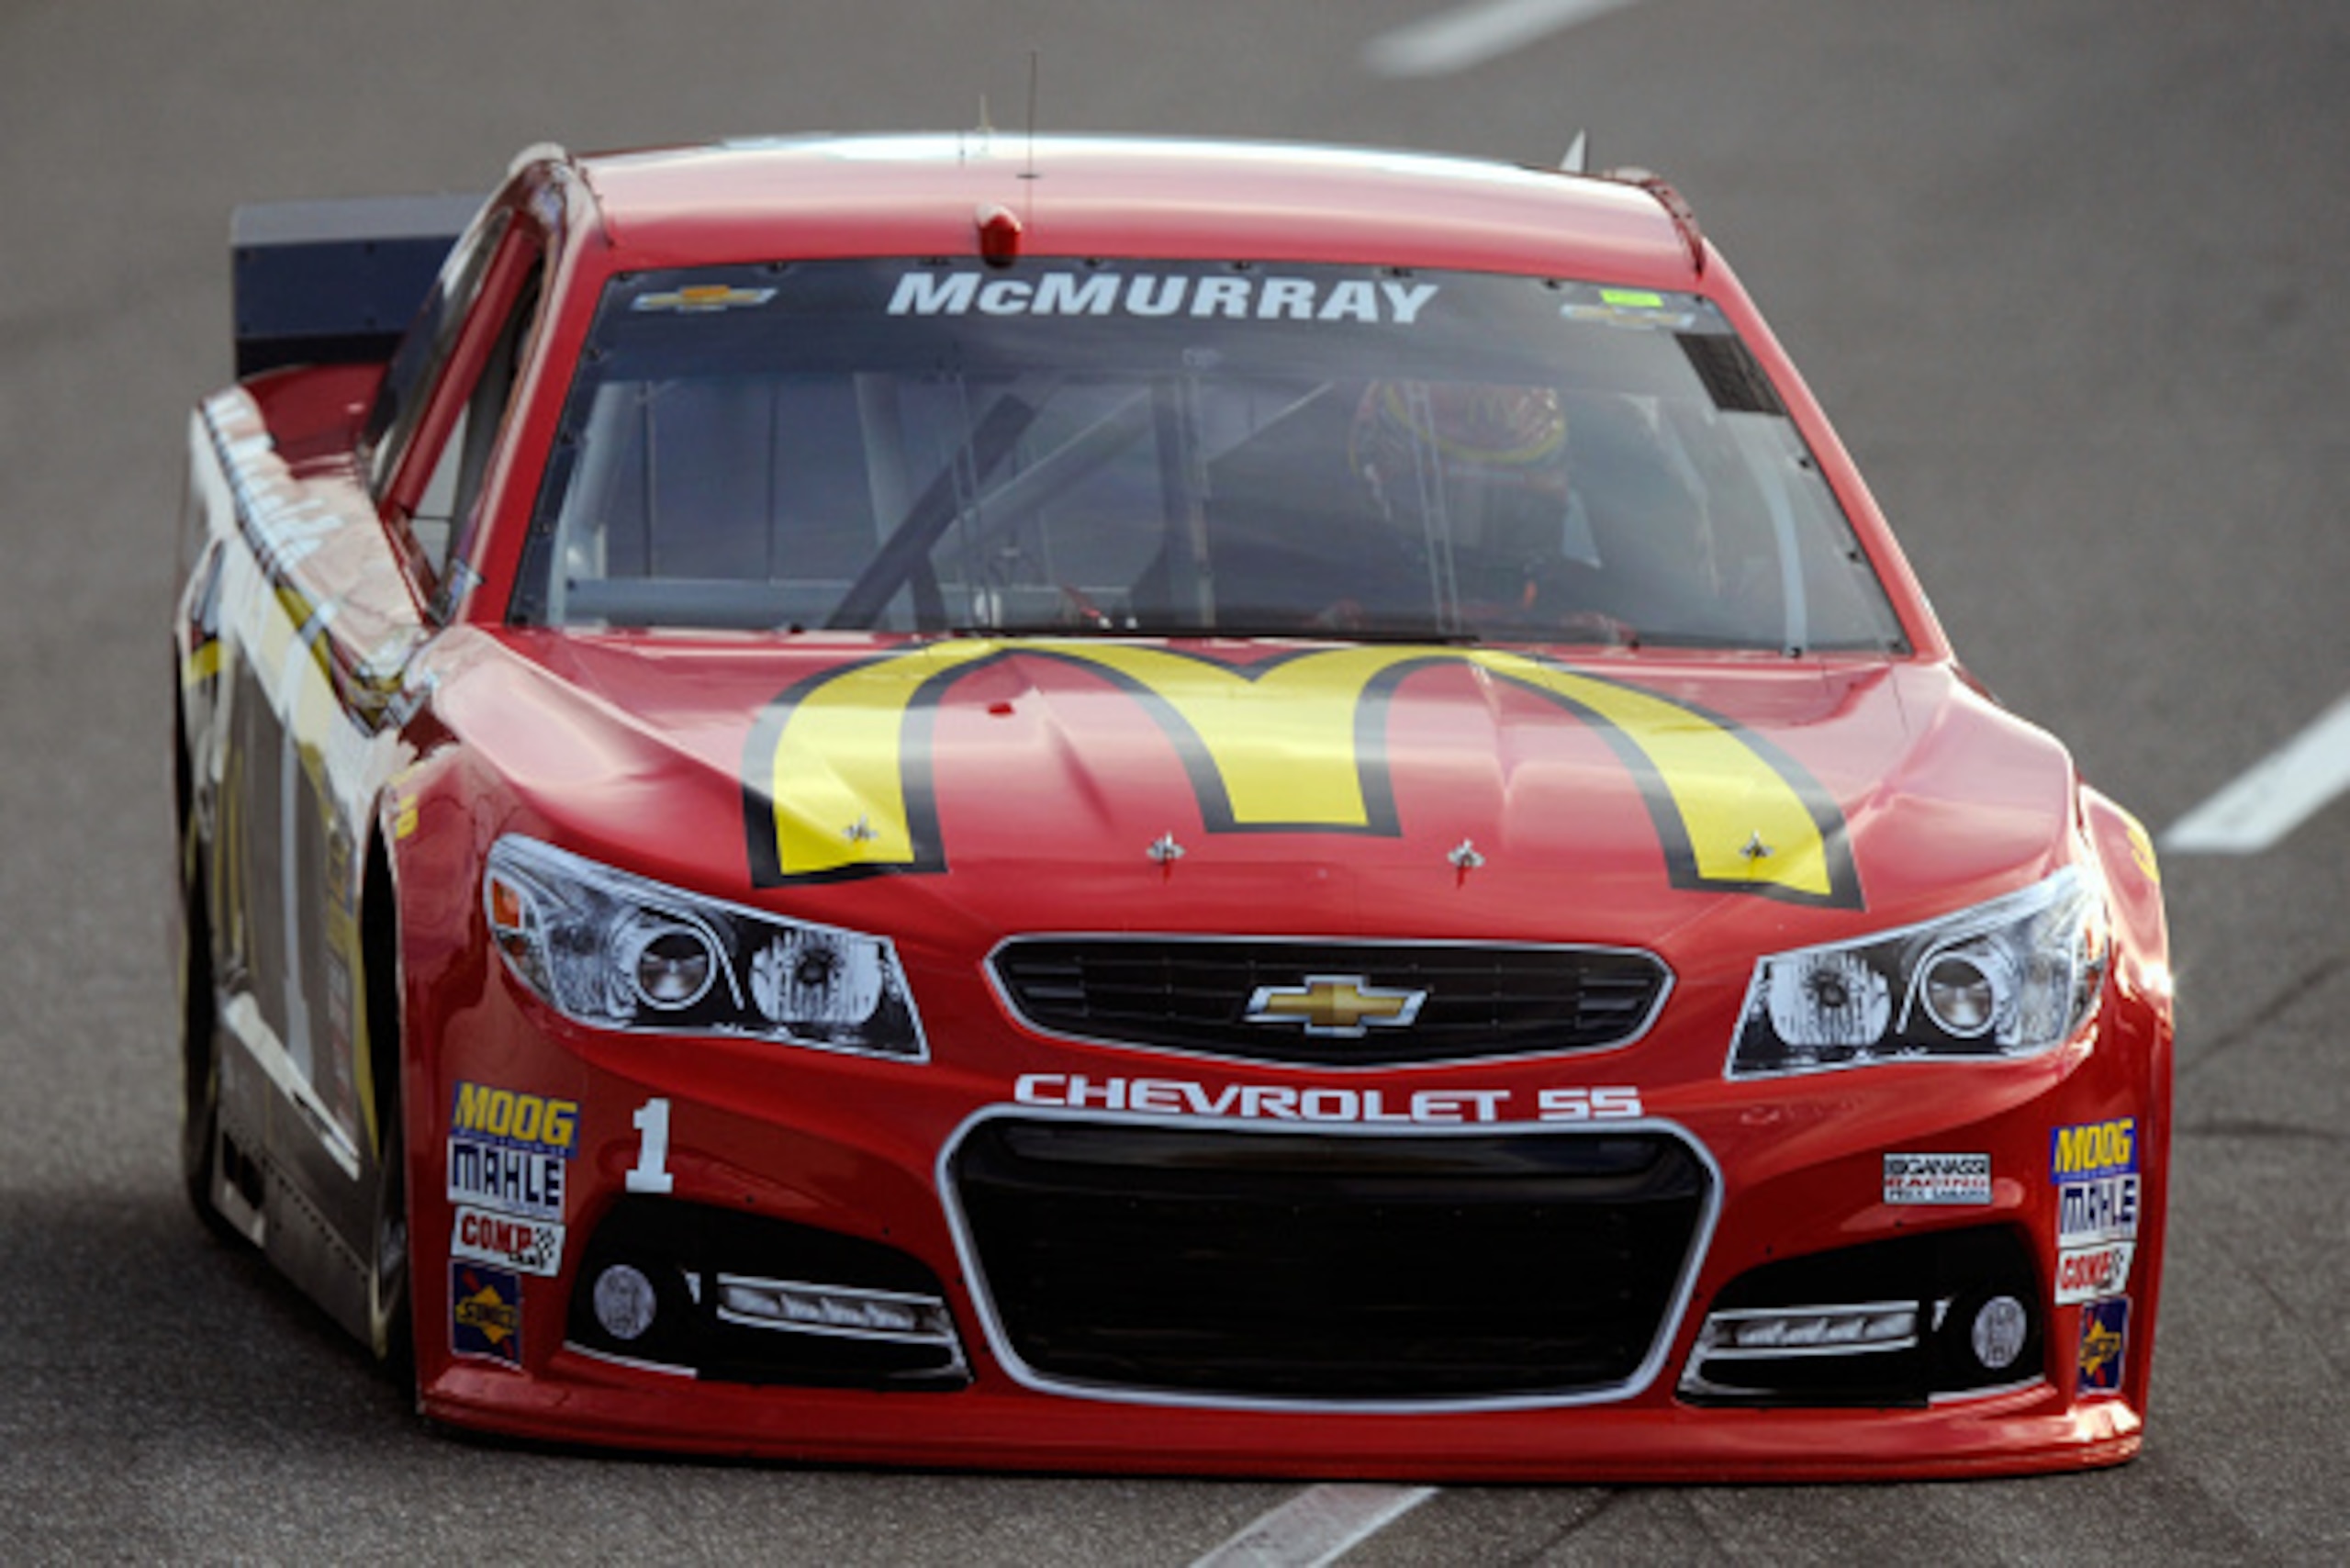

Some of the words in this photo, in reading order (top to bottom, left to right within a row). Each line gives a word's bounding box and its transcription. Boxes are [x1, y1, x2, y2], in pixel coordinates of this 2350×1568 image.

[887, 273, 1439, 324] McMURRAY
[453, 1081, 578, 1148] MOOG
[1014, 1073, 1510, 1123] CHEVROLET
[1538, 1087, 1643, 1122] SS
[625, 1097, 674, 1193] 1
[2054, 1117, 2134, 1173] MOOG
[453, 1143, 560, 1207] MAHLE
[461, 1211, 533, 1255] COMP
[2061, 1180, 2136, 1234] MAHLE
